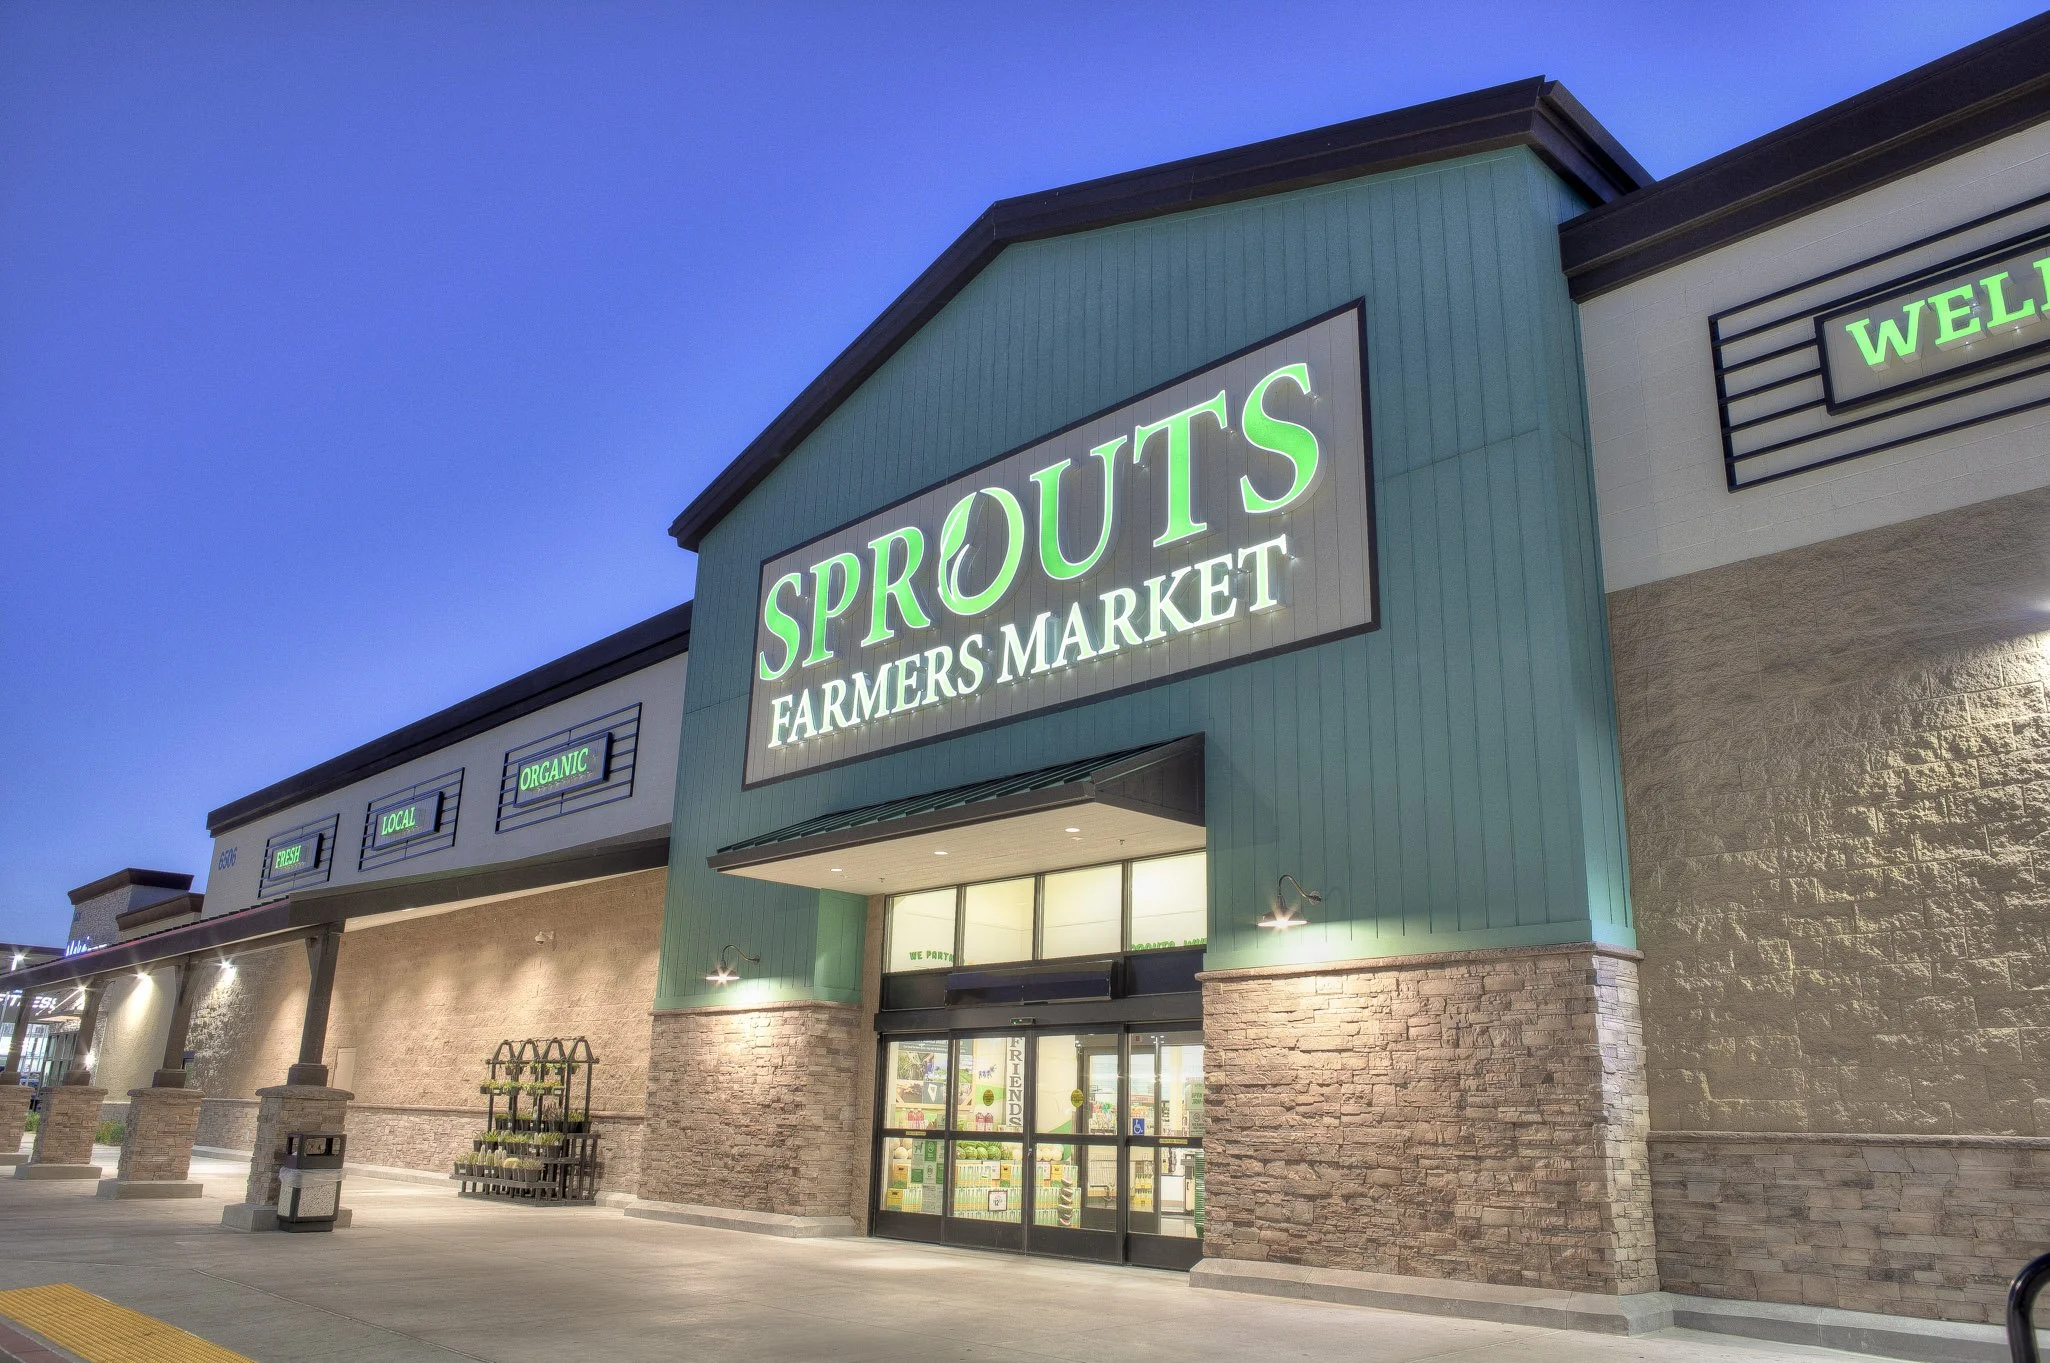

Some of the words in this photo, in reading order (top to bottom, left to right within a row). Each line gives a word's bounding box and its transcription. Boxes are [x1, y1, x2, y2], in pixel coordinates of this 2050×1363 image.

[760, 363, 1320, 681] SPROUTS
[768, 634, 988, 749] FARMERS
[997, 534, 1290, 684] MARKET
[520, 748, 590, 791] ORGANIC
[381, 806, 416, 836] LOCAL
[275, 845, 302, 869] FRESH
[909, 951, 923, 960] WE
[1008, 1037, 1023, 1126] FRIENDS
